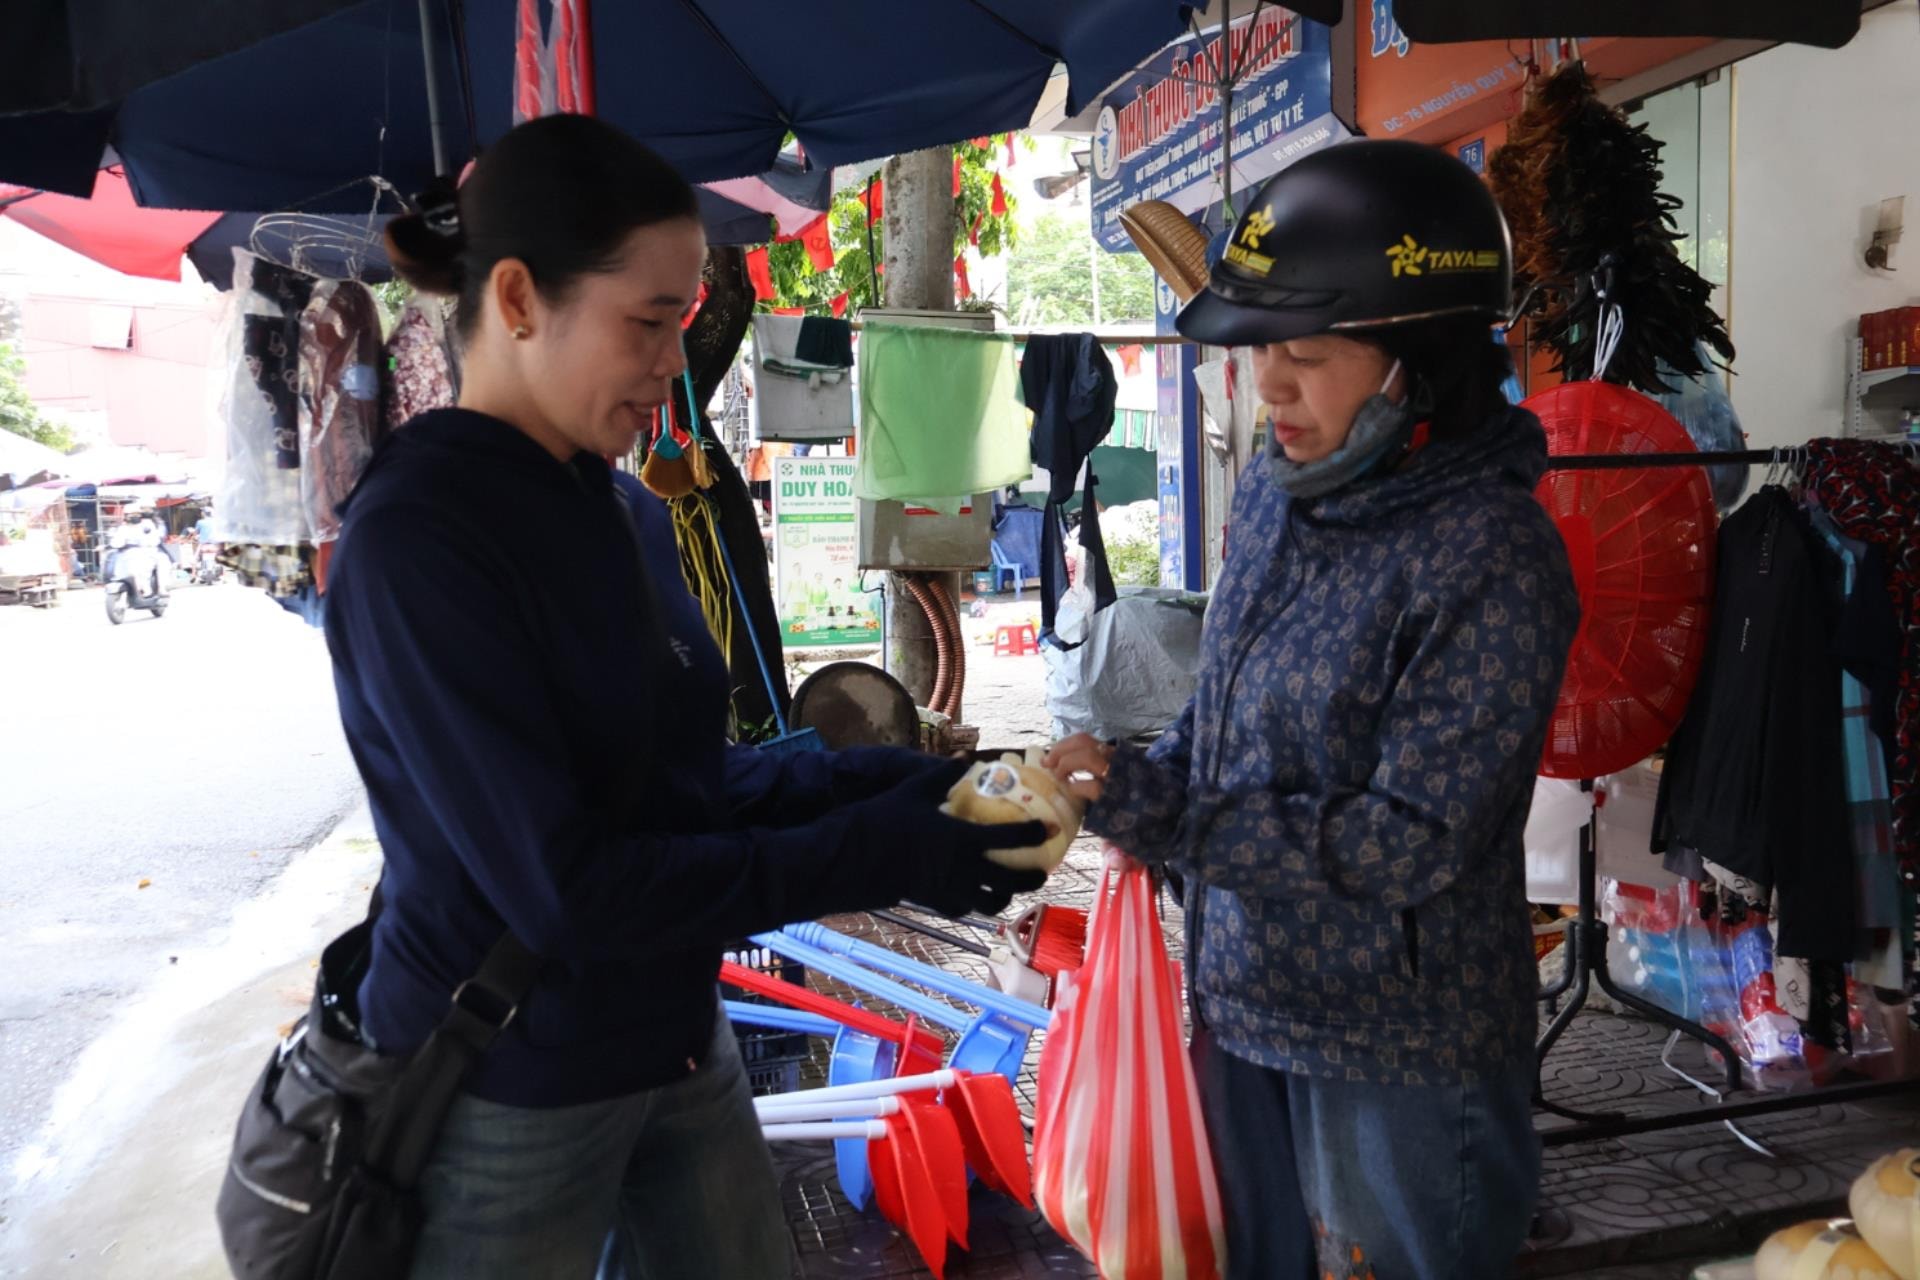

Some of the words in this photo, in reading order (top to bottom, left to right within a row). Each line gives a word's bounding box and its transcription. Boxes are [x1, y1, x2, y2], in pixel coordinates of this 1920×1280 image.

[1119, 84, 1145, 162] NHÀ
[1146, 46, 1192, 146] THUỐC
[1284, 106, 1291, 128] Y
[1291, 92, 1305, 124] TẾ
[1465, 147, 1477, 163] 76
[1428, 250, 1475, 269] TAYA
[799, 462, 826, 476] NHÀ
[829, 464, 856, 476] THU
[781, 481, 817, 497] DUY
